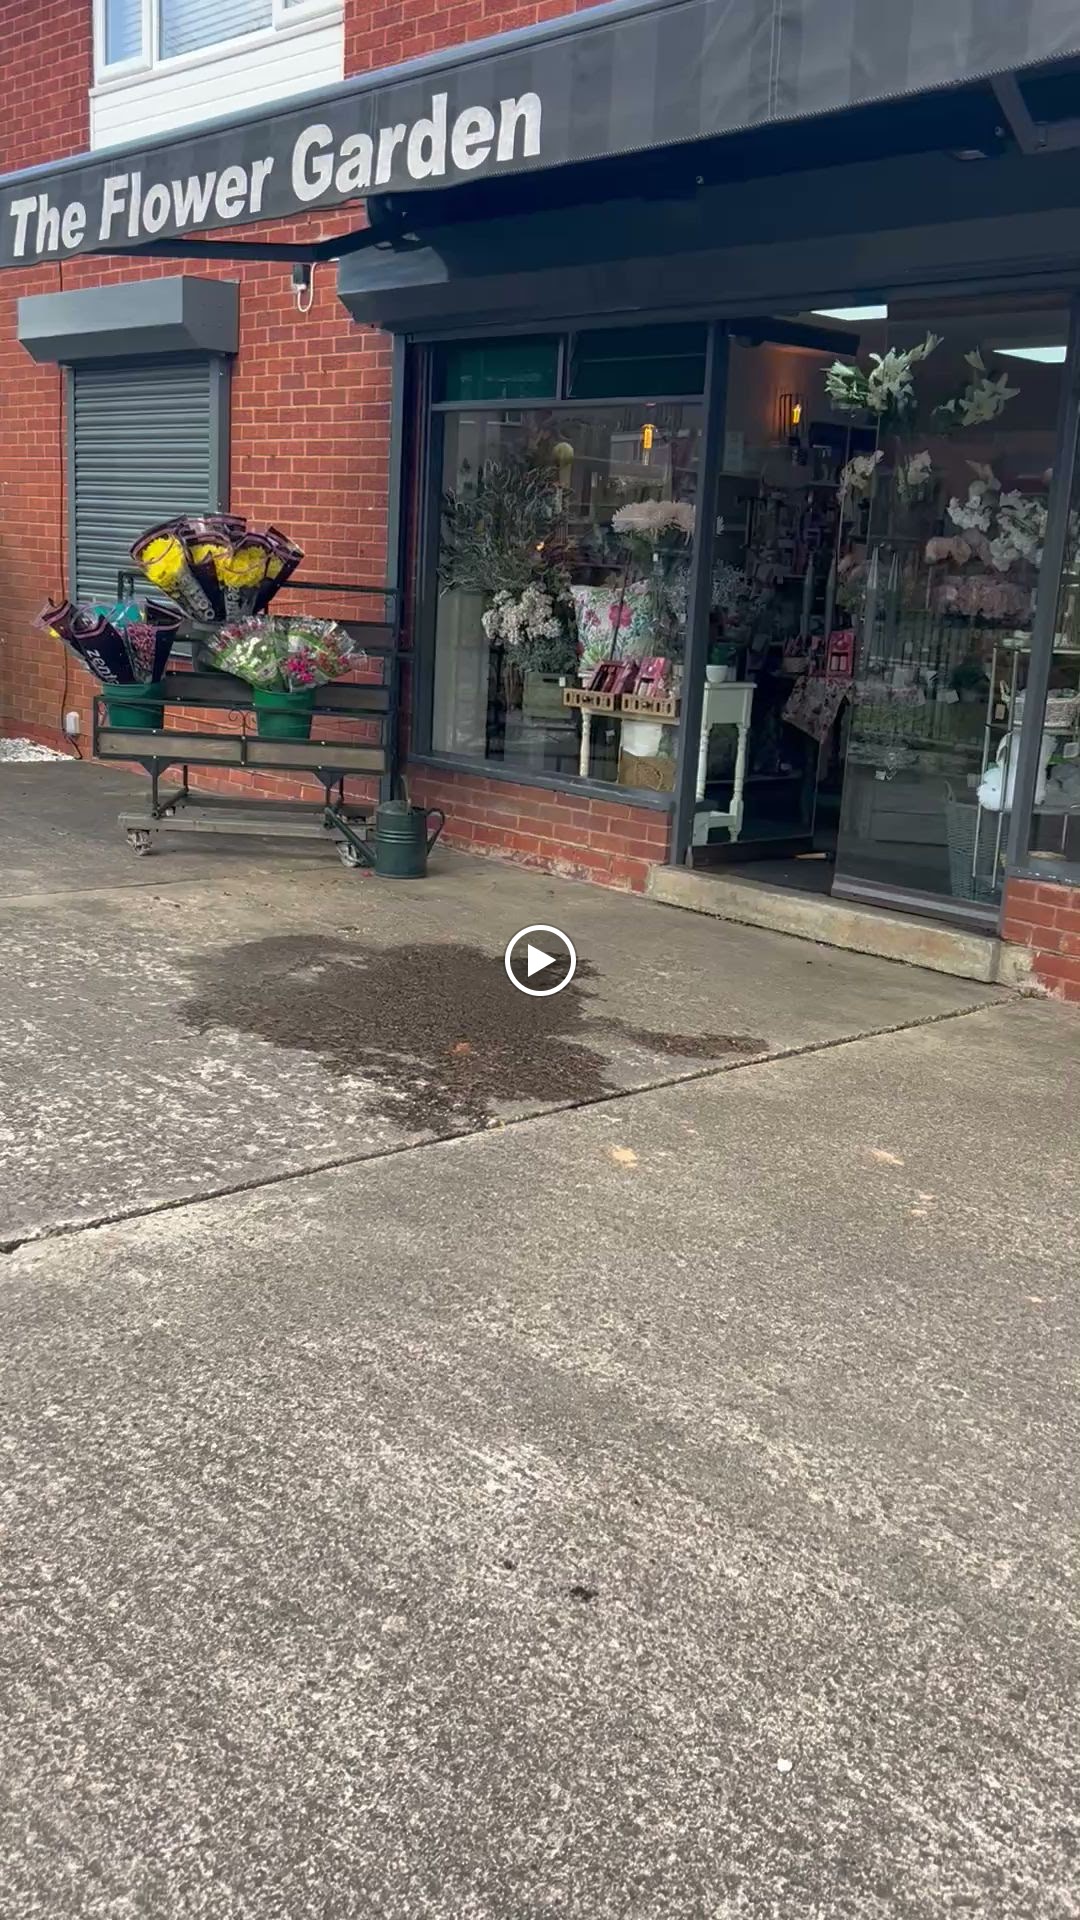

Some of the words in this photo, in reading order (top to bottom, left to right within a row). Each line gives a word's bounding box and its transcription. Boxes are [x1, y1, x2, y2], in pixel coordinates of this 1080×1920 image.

[10, 193, 85, 257] The
[99, 155, 274, 240] Flower
[292, 92, 542, 201] Garden
